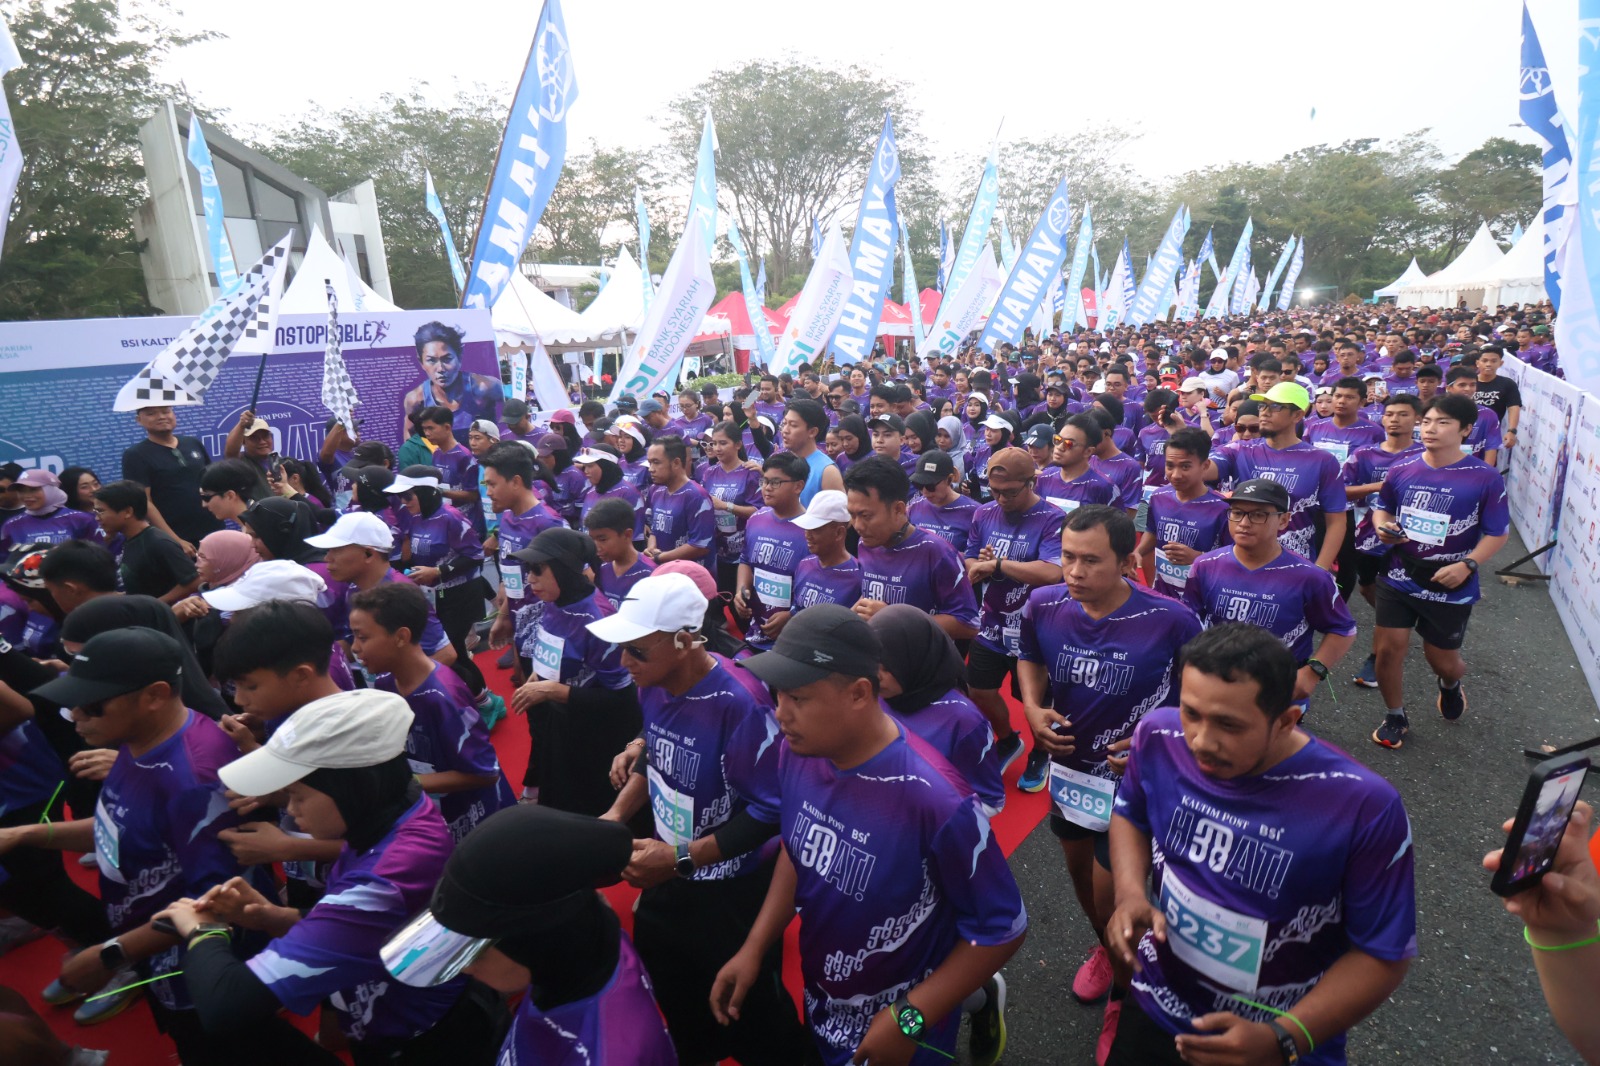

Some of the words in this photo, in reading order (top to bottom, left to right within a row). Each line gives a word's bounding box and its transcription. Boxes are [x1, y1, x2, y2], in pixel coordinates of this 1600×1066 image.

[957, 198, 992, 273] KALTIM
[648, 326, 671, 360] BANK
[667, 279, 701, 328] SYARIAH
[805, 311, 823, 339] BANK
[813, 292, 843, 342] INDONESIA
[120, 339, 140, 348] BSI
[141, 337, 178, 347] KALTI
[657, 305, 700, 364] INDONESIA
[939, 330, 961, 358] SI
[514, 366, 524, 392] BSI
[272, 411, 292, 421] POST
[1405, 516, 1444, 535] 5289
[1160, 562, 1190, 578] 4906
[757, 581, 784, 597] 4821
[1063, 644, 1088, 655] KALTIM
[1113, 652, 1128, 661] BSI
[1058, 786, 1107, 815] 4969
[802, 800, 826, 822] KALTIM
[828, 815, 845, 833] POST
[851, 828, 871, 845] BSI
[1181, 795, 1220, 819] KALTIM
[1221, 812, 1250, 830] POST
[1259, 823, 1285, 842] BSI
[1166, 896, 1251, 964] 5237
